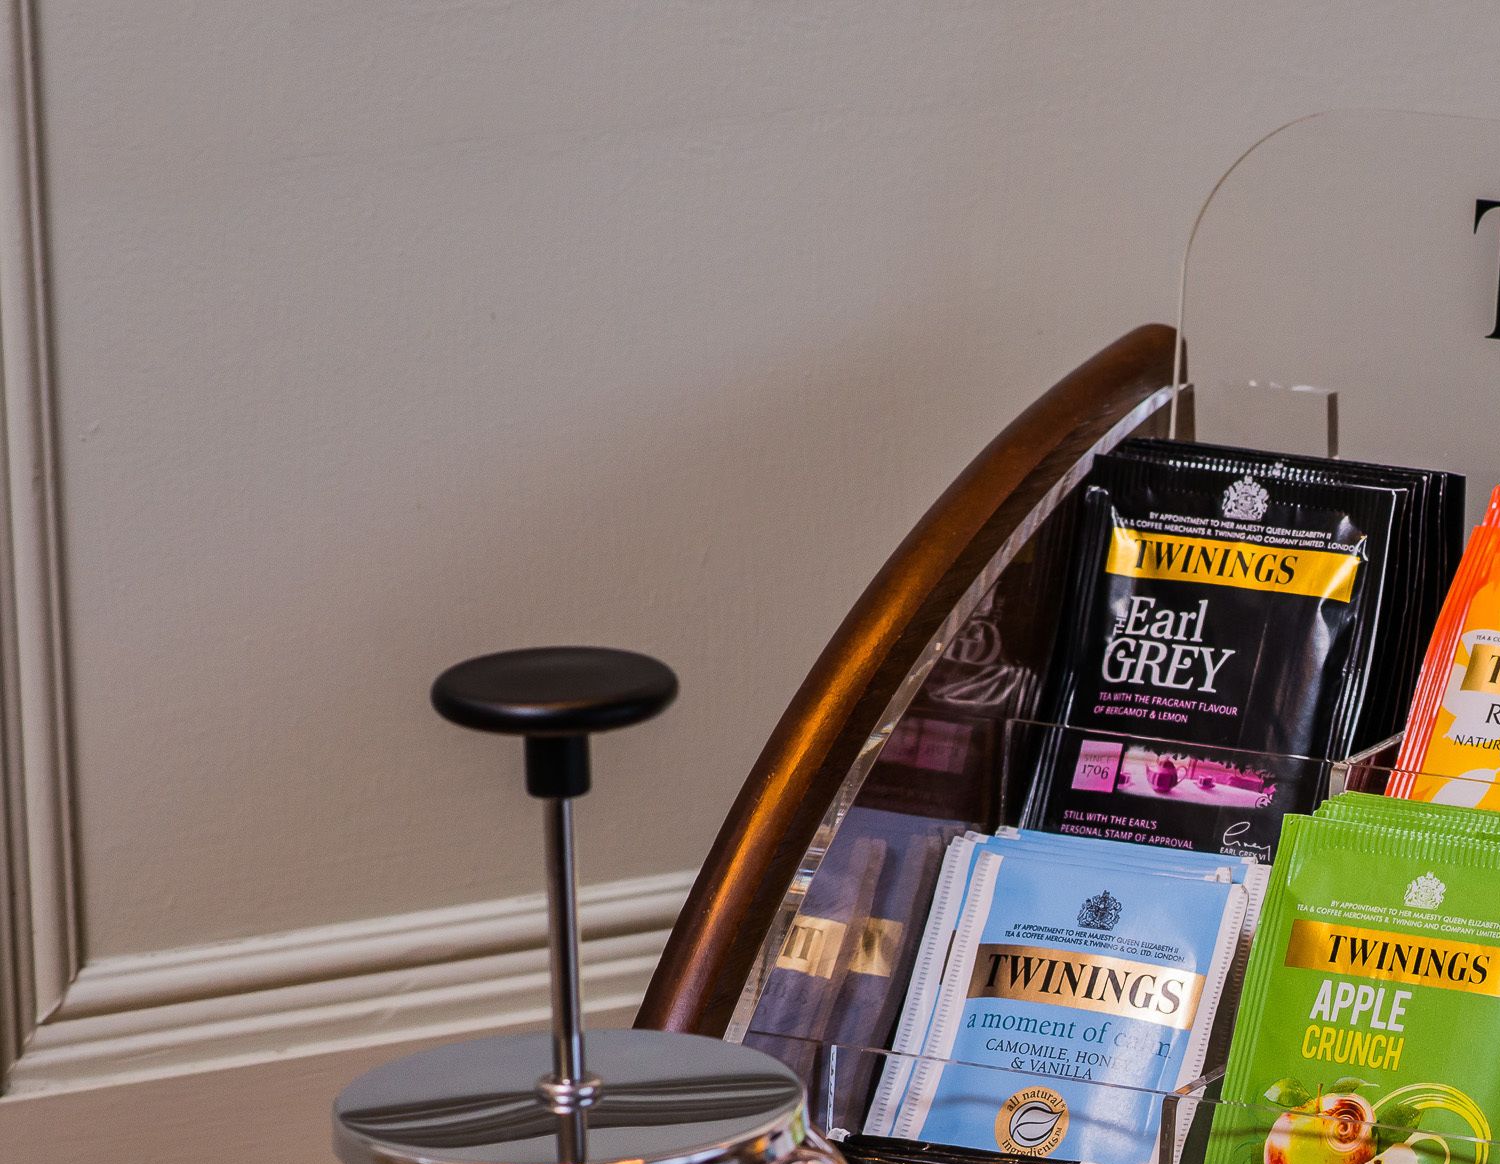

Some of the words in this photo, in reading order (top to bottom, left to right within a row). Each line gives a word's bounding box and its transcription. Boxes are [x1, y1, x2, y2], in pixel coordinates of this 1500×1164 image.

[1220, 521, 1235, 529] HER
[1236, 522, 1265, 533] MAJESTY
[1267, 526, 1291, 537] QUEEN
[1134, 538, 1298, 585] TWININGS
[1125, 596, 1209, 643] Earl
[1102, 637, 1236, 694] GREY
[1093, 705, 1104, 714] OF
[1105, 706, 1147, 718] BERGAMOT
[1149, 711, 1156, 719] &
[1158, 711, 1189, 723] LEMON
[1134, 694, 1149, 704] THE
[1151, 696, 1197, 710] FRAGRANT
[1198, 702, 1238, 716] FLAVOUR
[1082, 764, 1109, 779] 1706
[1063, 810, 1084, 820] STILL
[1086, 812, 1108, 822] WITH
[1110, 815, 1127, 826] THE
[1128, 818, 1158, 830] EARL'S
[1060, 823, 1102, 837] PERSONAL
[1104, 829, 1133, 840] STAMP
[1134, 833, 1147, 842] OF
[1148, 835, 1194, 850] APPROVAL
[1220, 847, 1236, 856] EARL
[1296, 903, 1308, 911] TEA
[1316, 906, 1342, 917] COFFEE
[1343, 910, 1384, 923] MERCHANTS
[1392, 917, 1422, 928] TWINING
[1423, 921, 1440, 930] AND
[1440, 923, 1476, 935] COMPANY
[1339, 901, 1388, 914] APPOINTMENT
[1398, 909, 1412, 917] HER
[1412, 911, 1443, 922] MAJESTY
[1443, 915, 1467, 925] QUEEN
[1021, 924, 1064, 935] APPOINTMENT
[1074, 930, 1087, 938] HER
[1088, 931, 1116, 942] MAJESTY
[1116, 936, 1140, 947] QUEEN
[1140, 939, 1174, 953] ELIZABETH
[1021, 932, 1045, 941] COFFEE
[1045, 934, 1083, 946] MERCHANTS
[1327, 934, 1491, 985] TWININGS
[988, 953, 1185, 1015] TWININGS
[1309, 979, 1412, 1032] APPLE
[966, 1013, 977, 1029] a
[981, 1013, 1076, 1039] moment
[1083, 1021, 1112, 1044] of
[985, 1038, 1070, 1063] CAMOMILE,
[1301, 1024, 1405, 1071] CRUNCH
[1010, 1056, 1025, 1070] &
[1030, 1059, 1093, 1080] VANILLA
[1006, 1095, 1020, 1112] all
